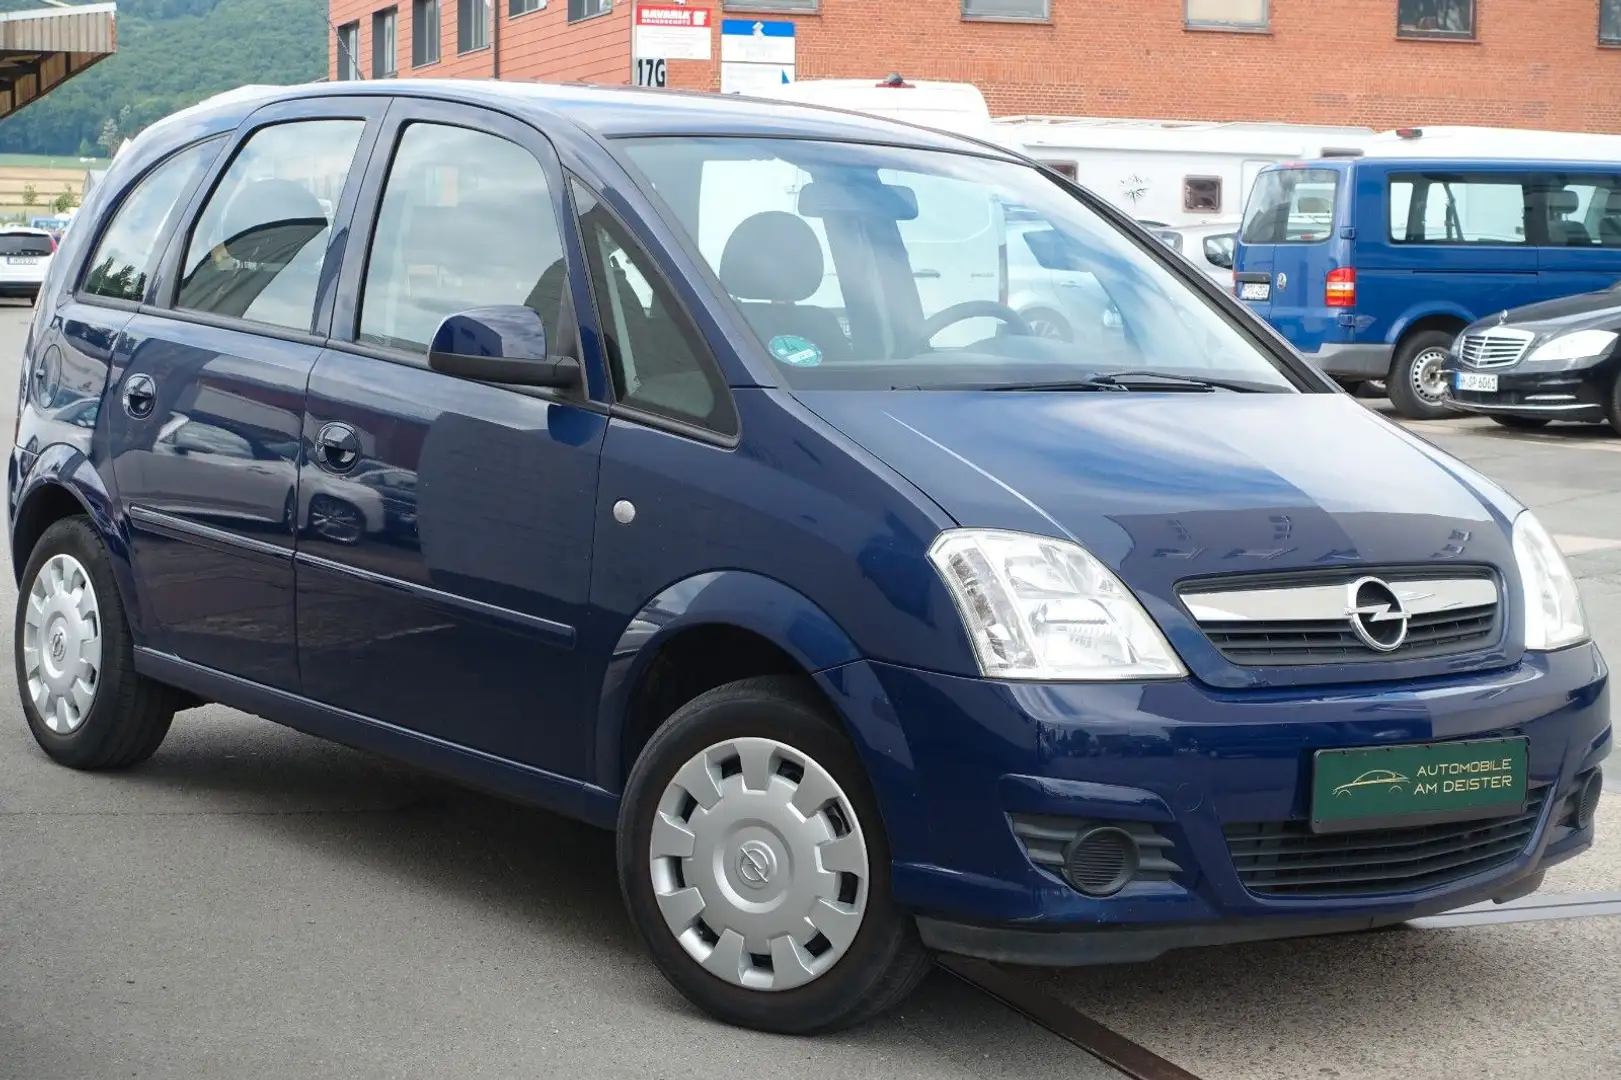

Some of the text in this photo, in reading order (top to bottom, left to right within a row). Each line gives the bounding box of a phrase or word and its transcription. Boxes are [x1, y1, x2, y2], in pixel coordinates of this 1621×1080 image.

[638, 59, 665, 87] 17G
[1416, 758, 1512, 777] AUTOMOBILE
[1413, 775, 1512, 795] AM DEISTER
